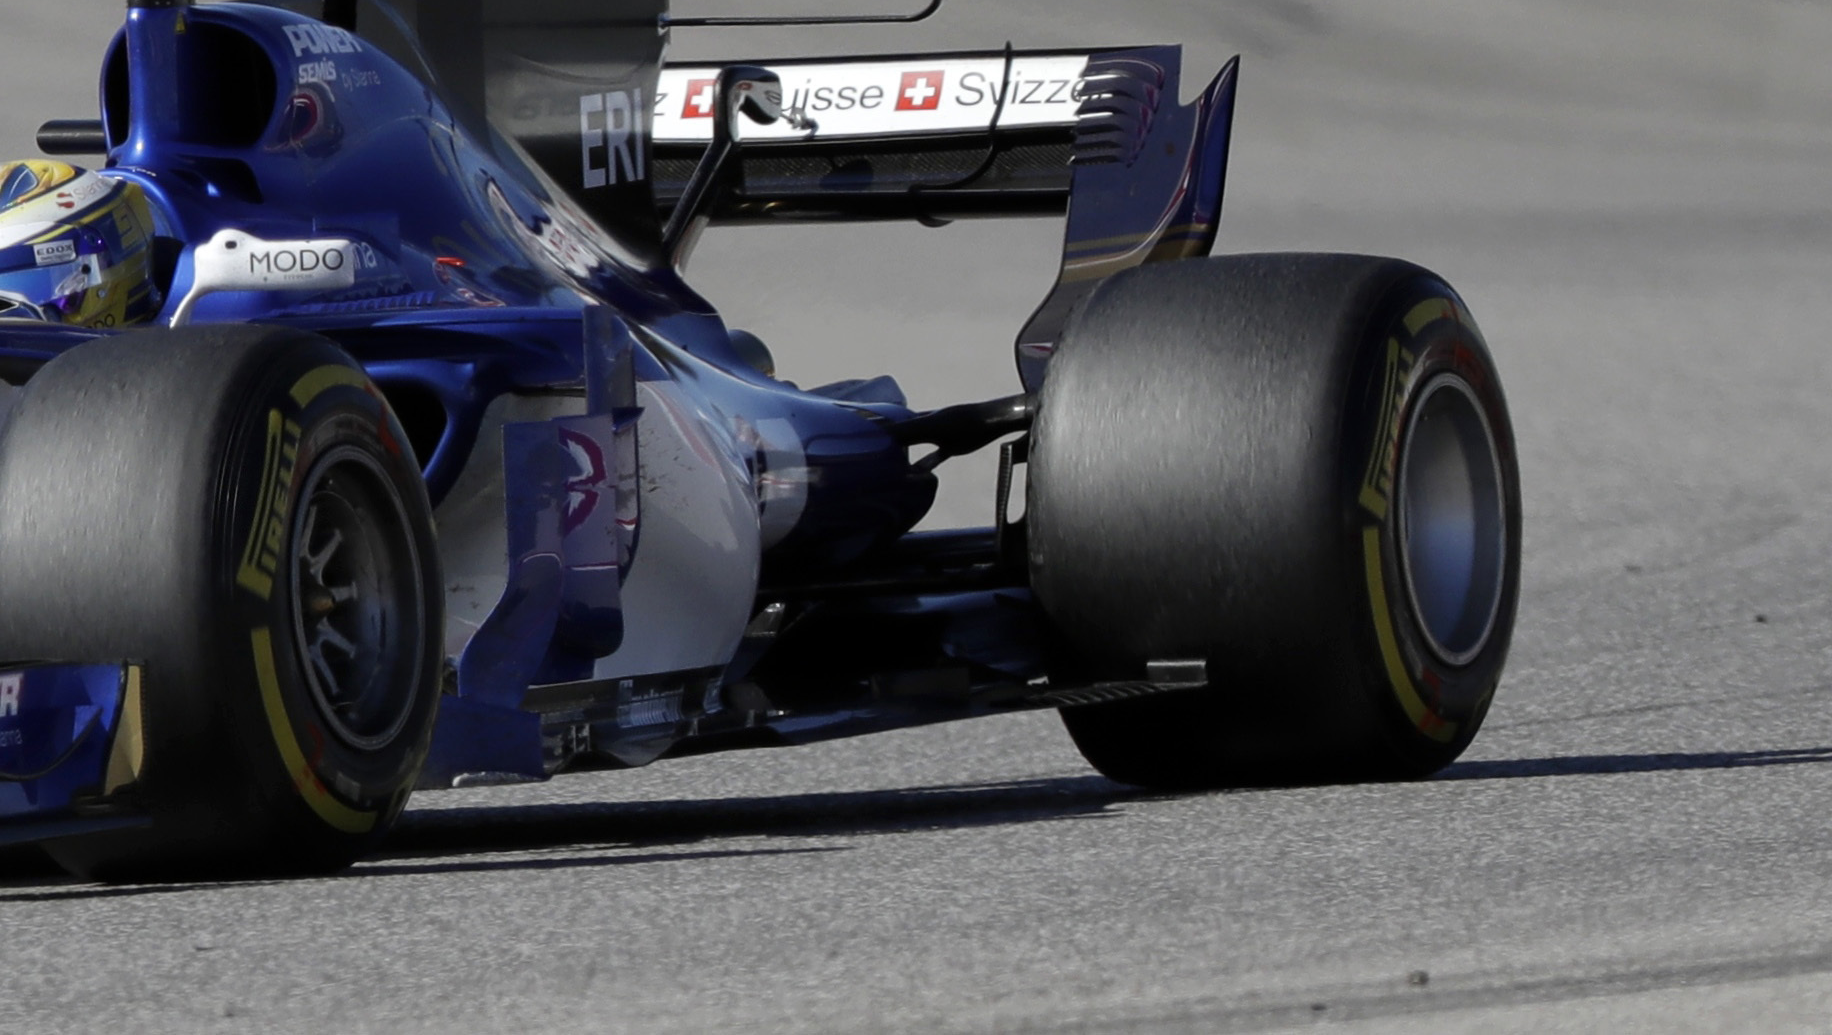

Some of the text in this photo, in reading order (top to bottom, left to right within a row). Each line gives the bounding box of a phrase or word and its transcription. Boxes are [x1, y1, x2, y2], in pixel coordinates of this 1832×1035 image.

[282, 24, 363, 57] POWER
[781, 79, 884, 112] uisse
[580, 87, 645, 189] ERI
[36, 243, 75, 257] EDOX
[249, 248, 344, 273] MODO
[237, 408, 303, 600] PIRELLI
